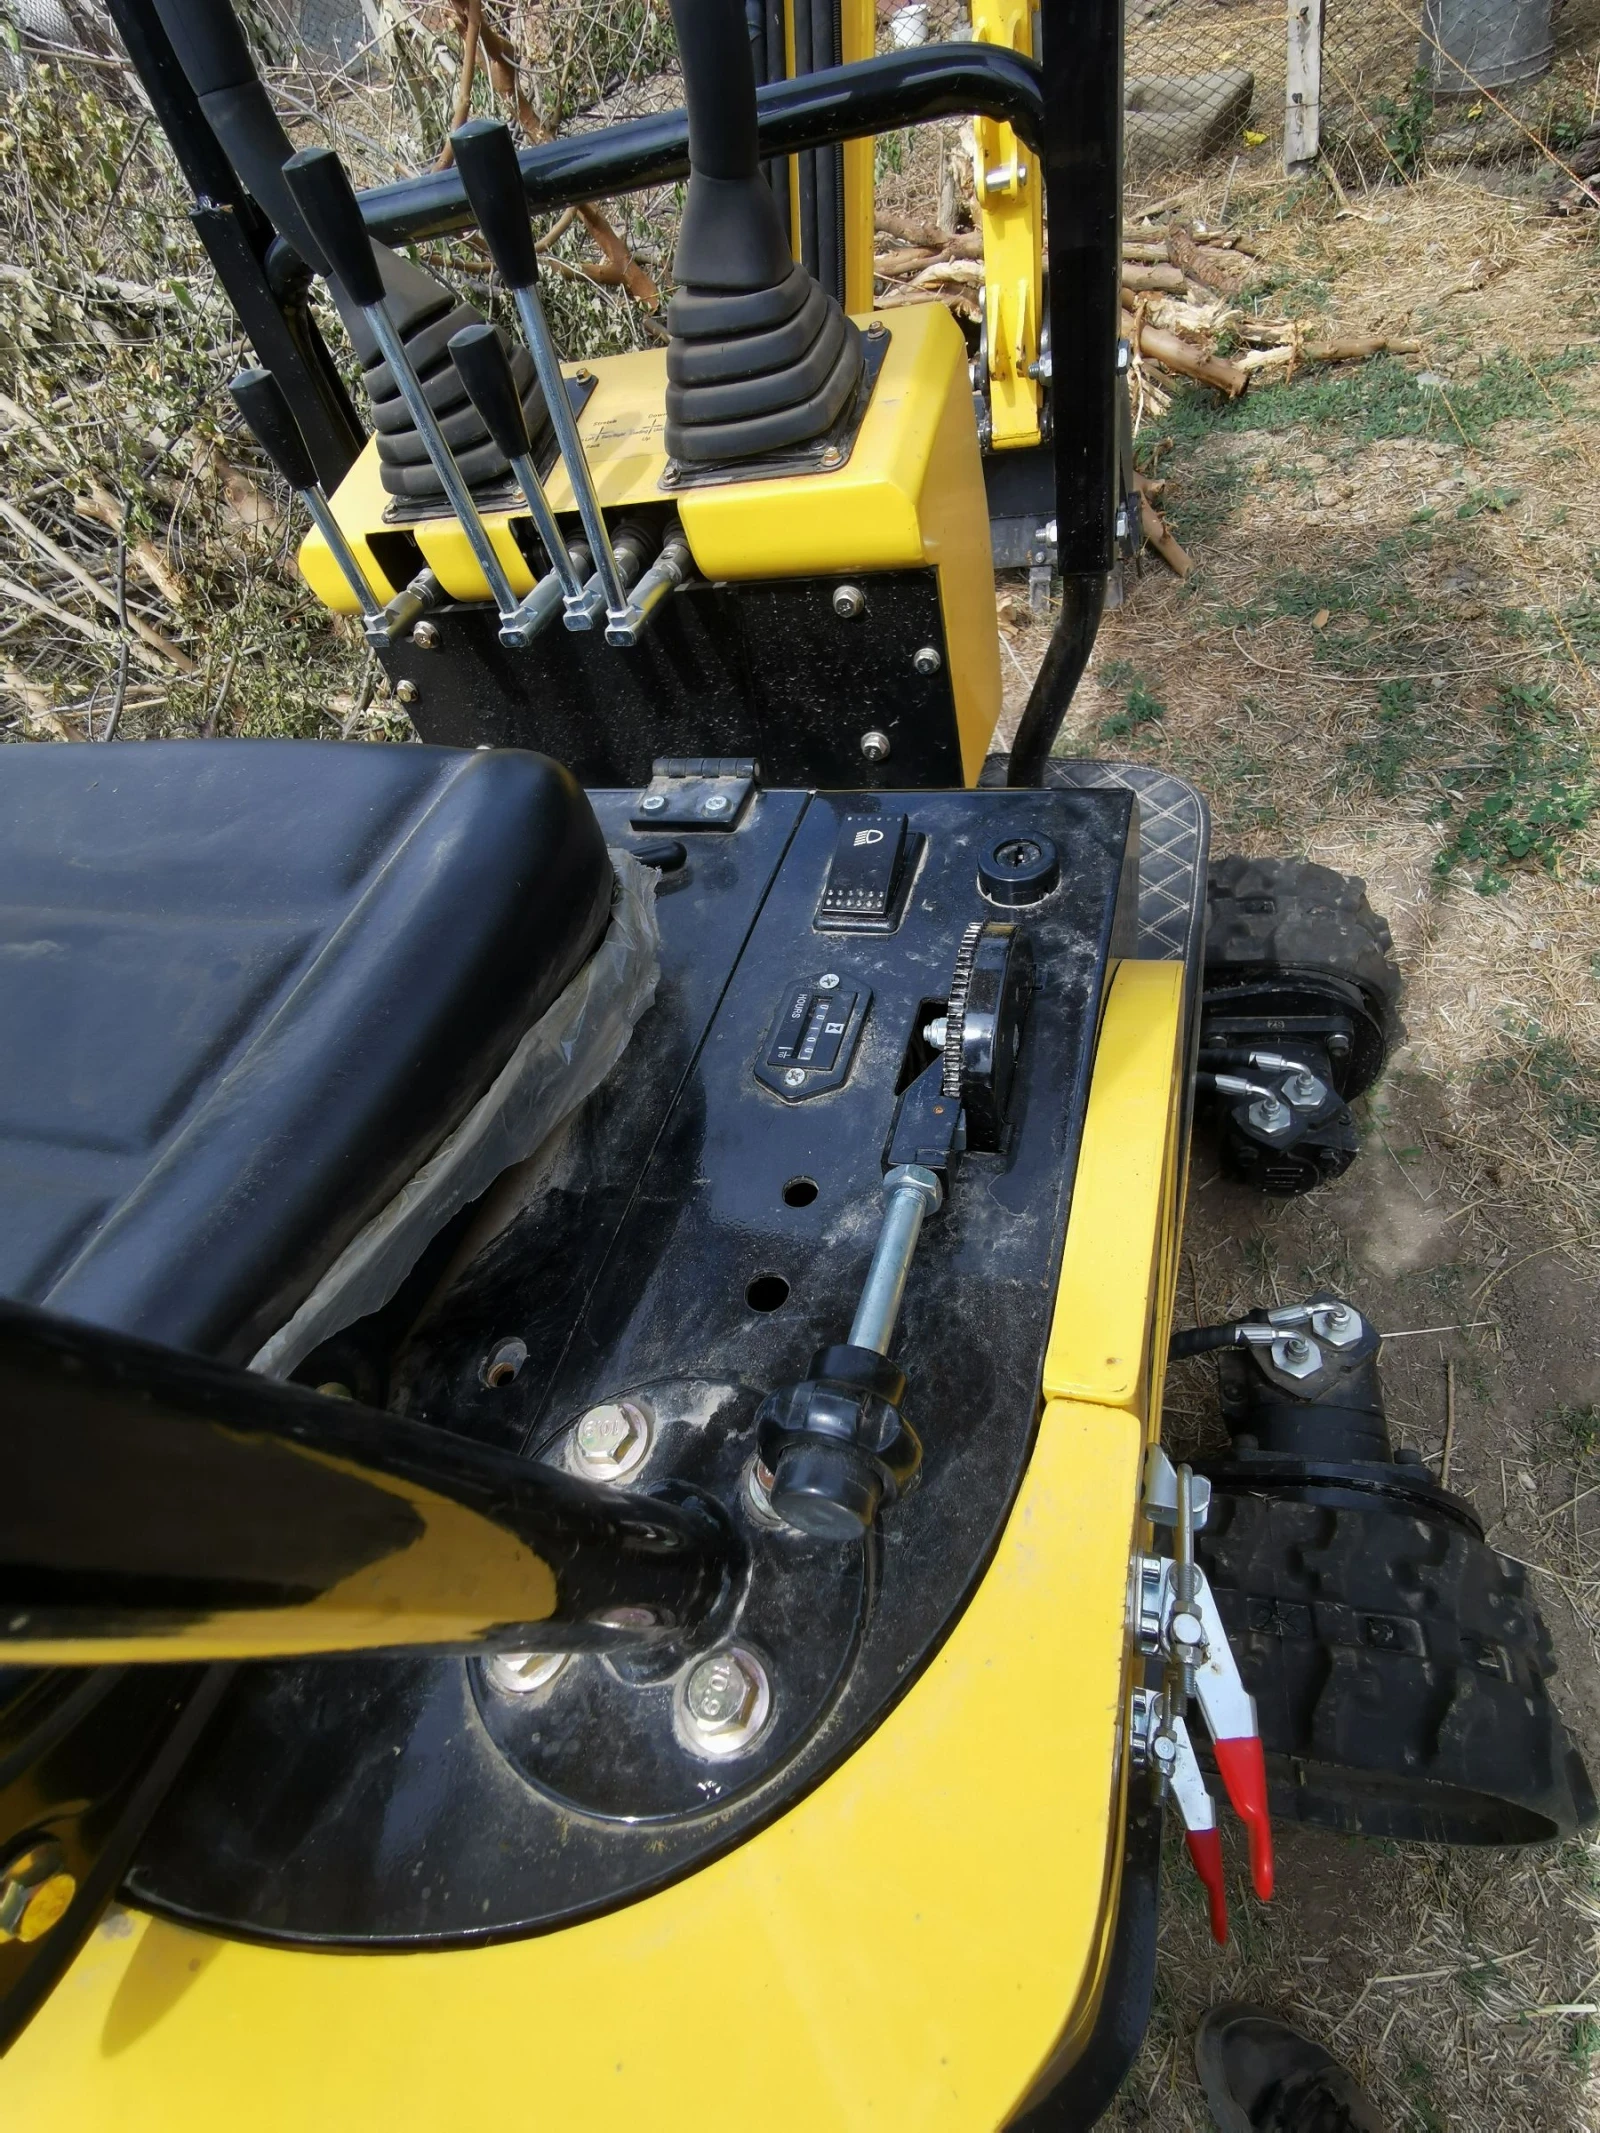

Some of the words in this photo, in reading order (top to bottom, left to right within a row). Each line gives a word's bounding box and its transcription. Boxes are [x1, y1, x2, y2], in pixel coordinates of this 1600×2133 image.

[792, 993, 807, 1019] HOURS
[583, 1420, 619, 1437] 10.9
[701, 1665, 730, 1716] 10.9
